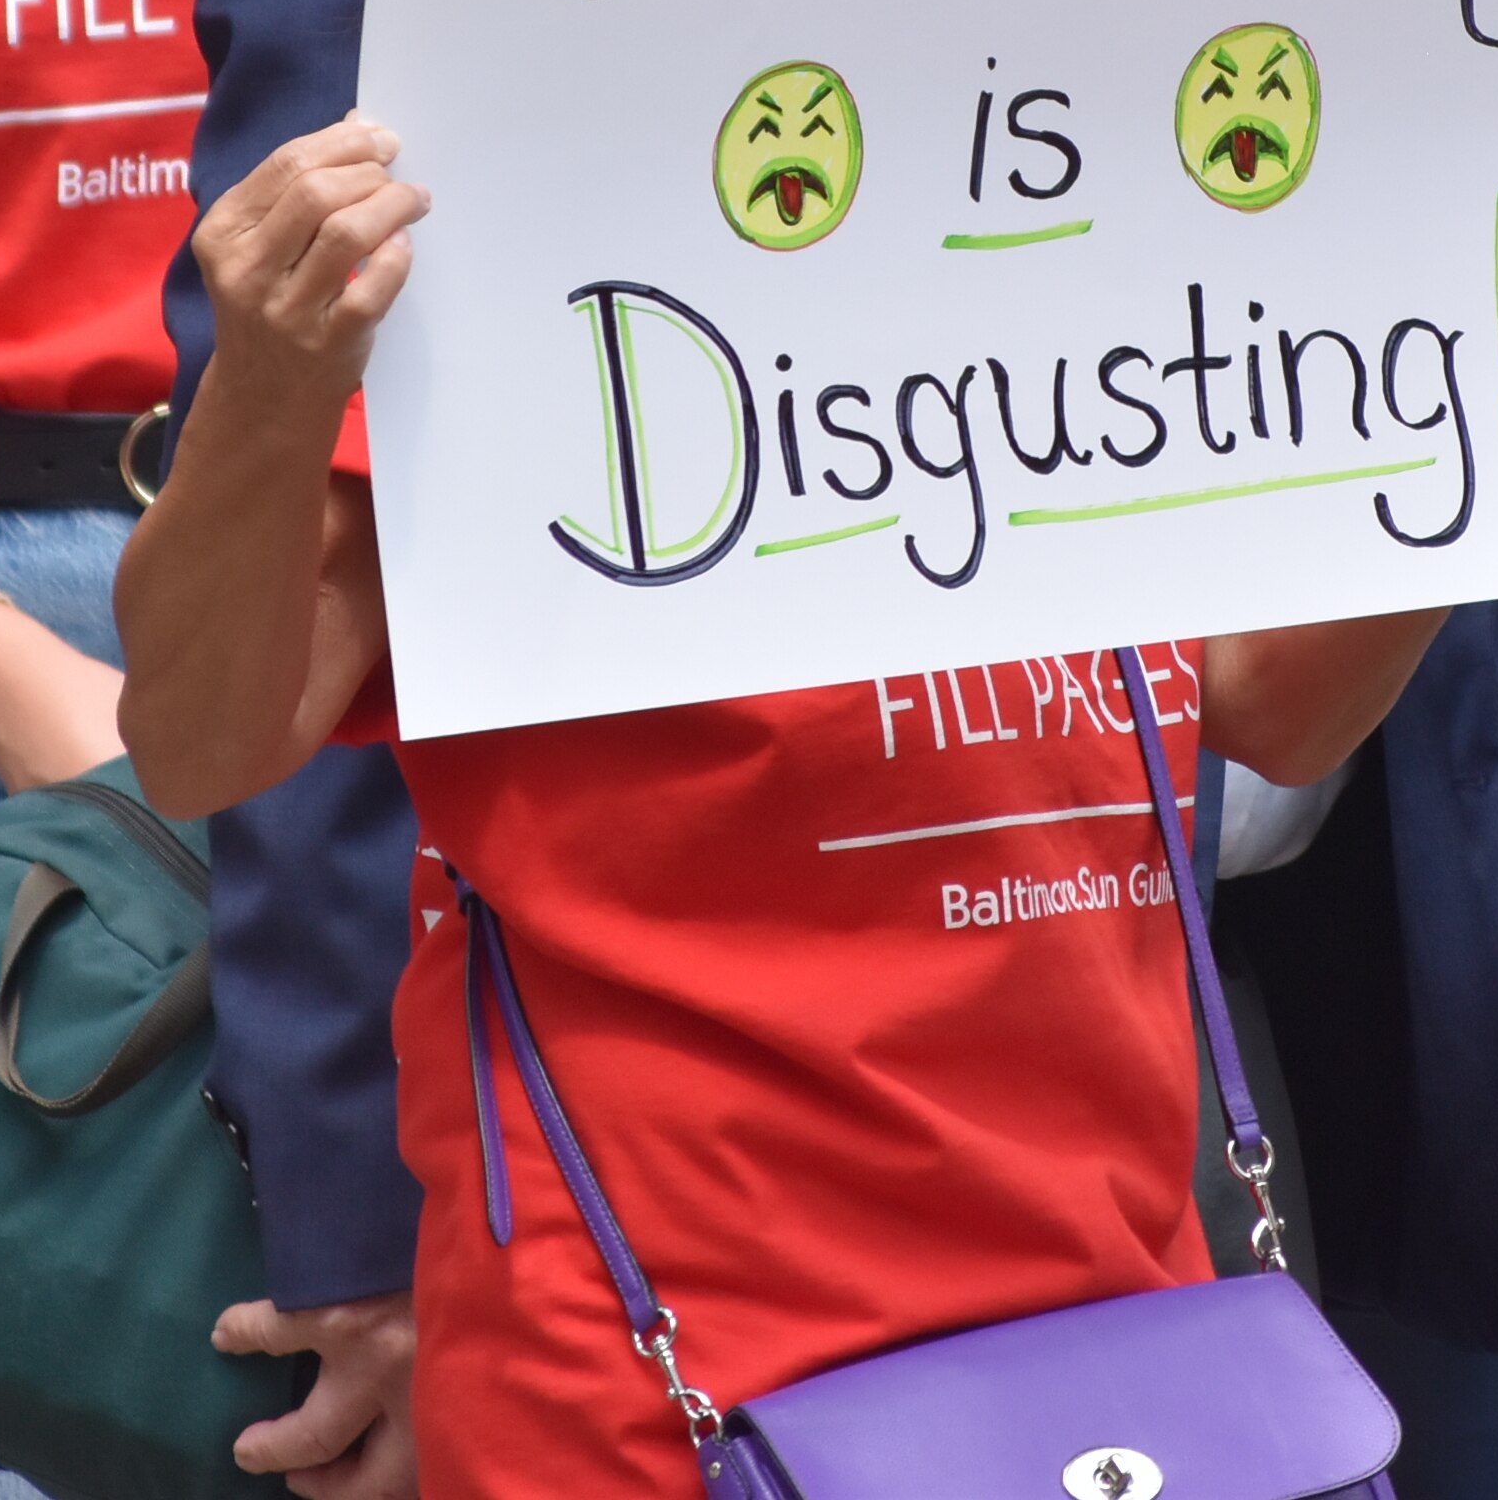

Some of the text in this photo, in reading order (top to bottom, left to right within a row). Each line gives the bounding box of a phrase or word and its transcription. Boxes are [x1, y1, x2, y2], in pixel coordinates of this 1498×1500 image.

[968, 56, 1083, 204] is
[875, 665, 1018, 760] FILL
[1077, 865, 1120, 911] Sun
